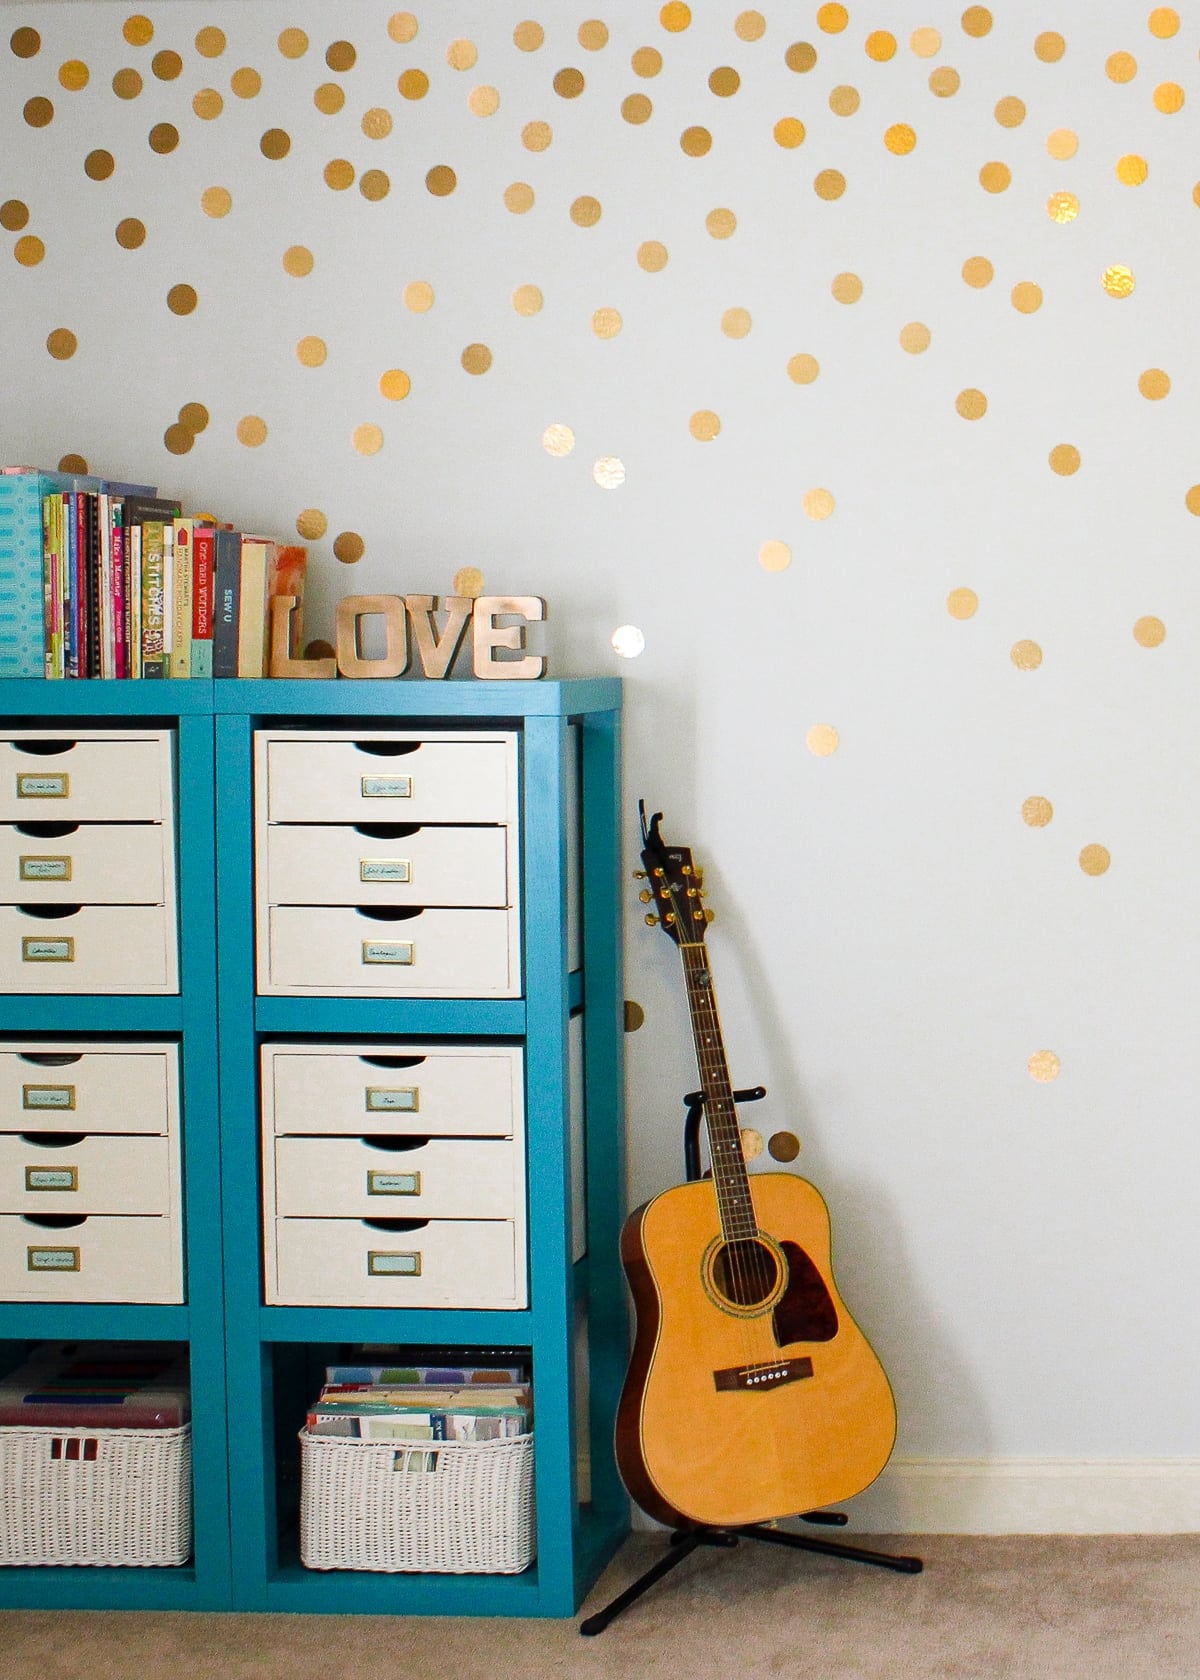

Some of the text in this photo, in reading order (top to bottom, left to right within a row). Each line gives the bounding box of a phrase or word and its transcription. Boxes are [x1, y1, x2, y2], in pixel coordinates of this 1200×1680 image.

[113, 535, 121, 556] Make
[113, 564, 122, 598] Monster
[148, 552, 161, 626] STITCHES
[223, 588, 233, 623] SEW U
[268, 594, 548, 681] LOVE
